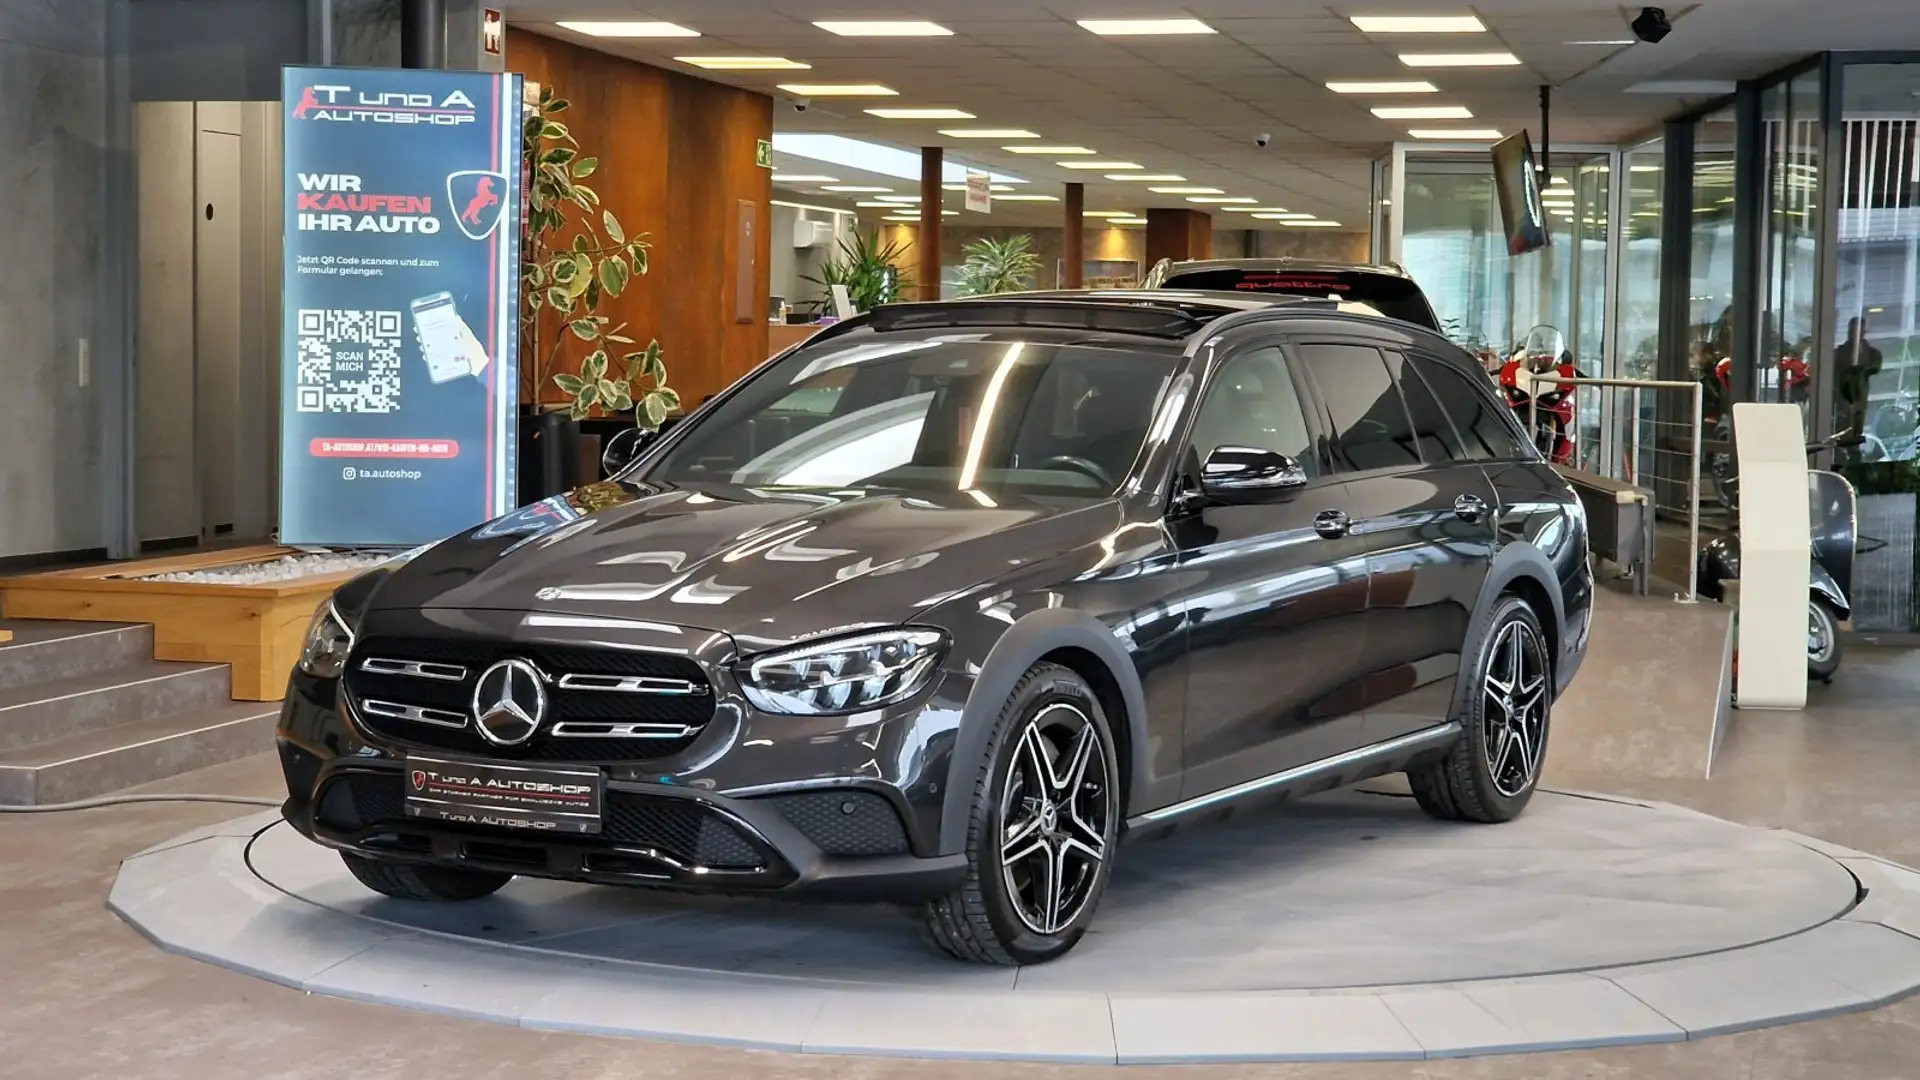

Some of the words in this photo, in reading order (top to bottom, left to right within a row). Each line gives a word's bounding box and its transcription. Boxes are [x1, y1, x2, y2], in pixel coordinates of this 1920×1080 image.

[314, 85, 351, 103] T
[440, 90, 475, 109] A
[313, 110, 475, 125] AUTOSHOP
[297, 173, 361, 192] WIR
[297, 193, 431, 214] KAUFEN
[298, 214, 356, 232] IHR
[357, 216, 440, 234] AUTO
[297, 255, 319, 264] Jetzt
[320, 256, 335, 265] QR
[336, 256, 359, 265] Code
[361, 257, 398, 266] scannen
[400, 257, 418, 266] und
[419, 259, 439, 267] zum
[297, 265, 337, 274] Formular
[1236, 281, 1350, 290] quattro
[336, 351, 363, 361] SCAN
[335, 362, 363, 371] MICH
[359, 469, 421, 480] ta.autoshop
[427, 772, 439, 780] T
[470, 777, 482, 786] A
[487, 779, 591, 794] AUTOSHOP
[439, 811, 449, 819] T
[467, 814, 476, 823] A
[481, 816, 556, 829] AUTOSHOP
